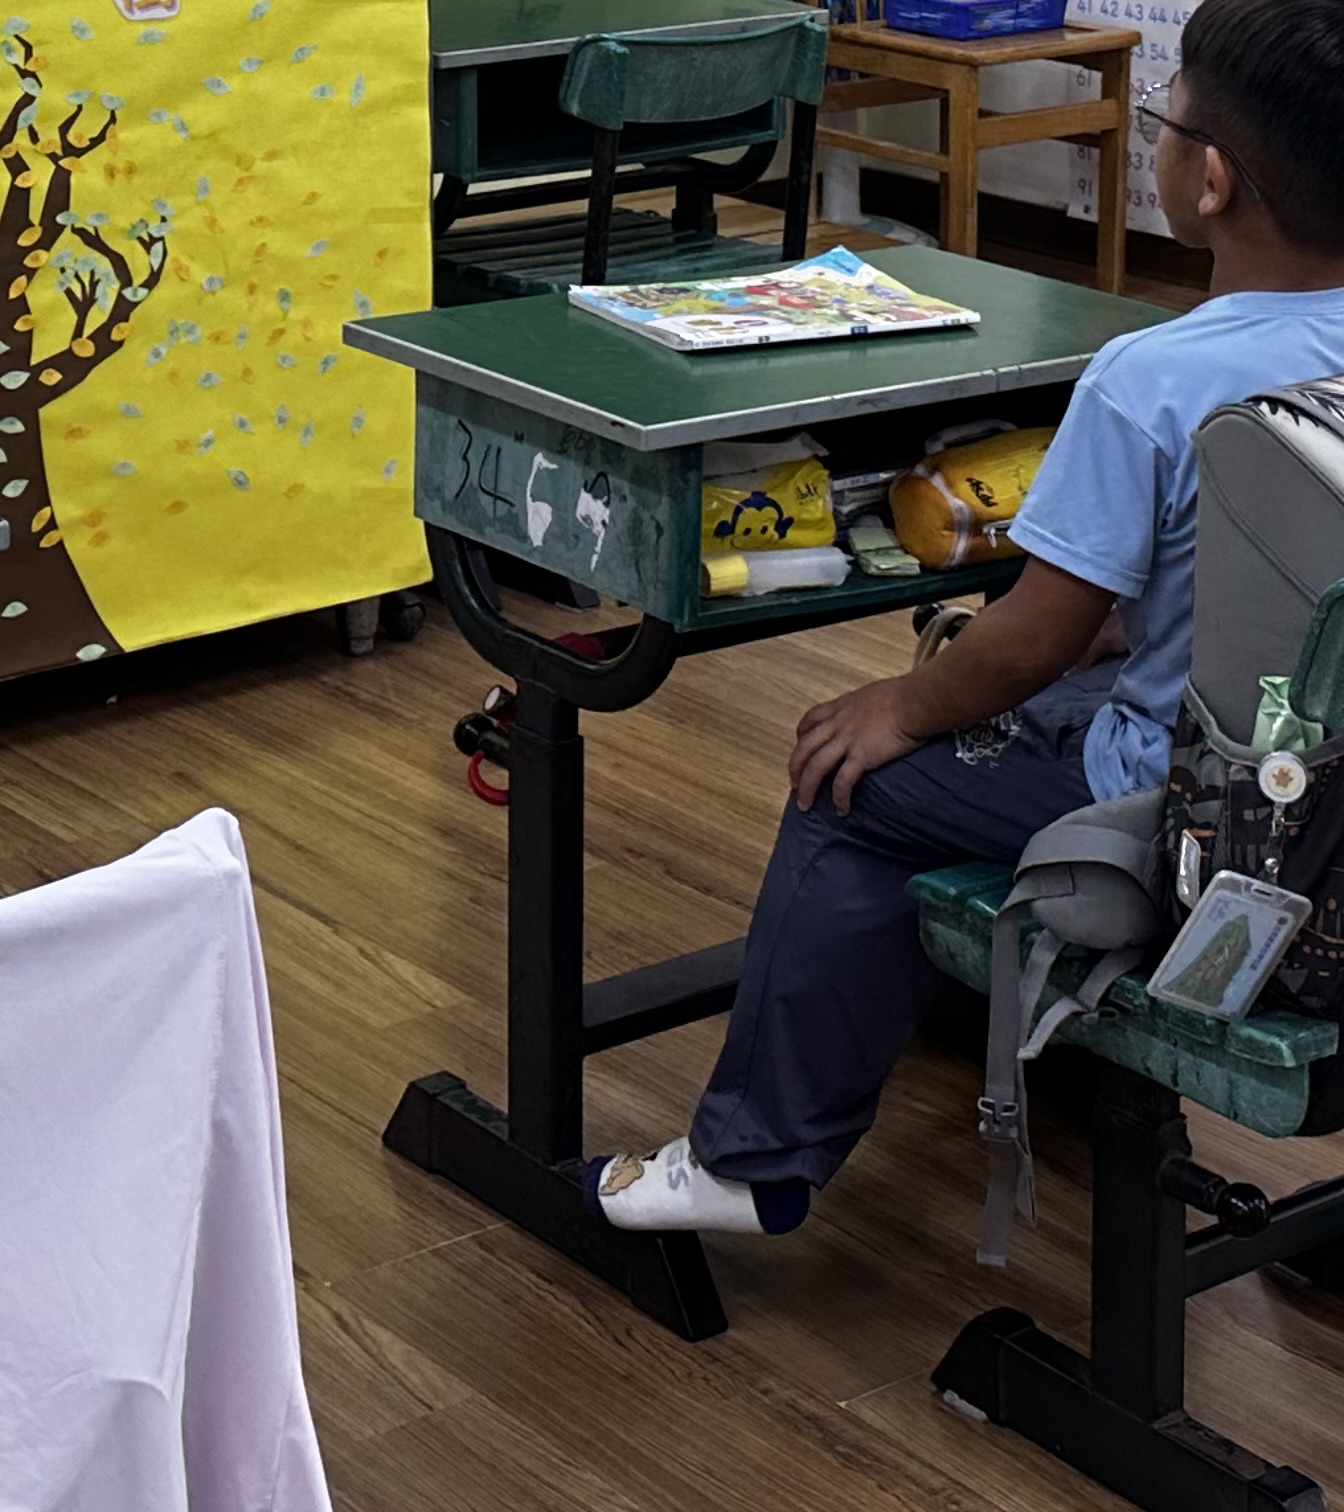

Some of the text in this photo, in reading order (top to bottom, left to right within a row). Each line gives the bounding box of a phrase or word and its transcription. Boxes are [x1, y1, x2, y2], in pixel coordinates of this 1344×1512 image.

[1100, 0, 1119, 18] 42
[1124, 3, 1144, 22] 43
[1148, 5, 1167, 24] 44
[1172, 9, 1190, 27] 45
[1150, 44, 1168, 62] 54
[1077, 69, 1092, 87] 61
[1078, 179, 1092, 197] 91
